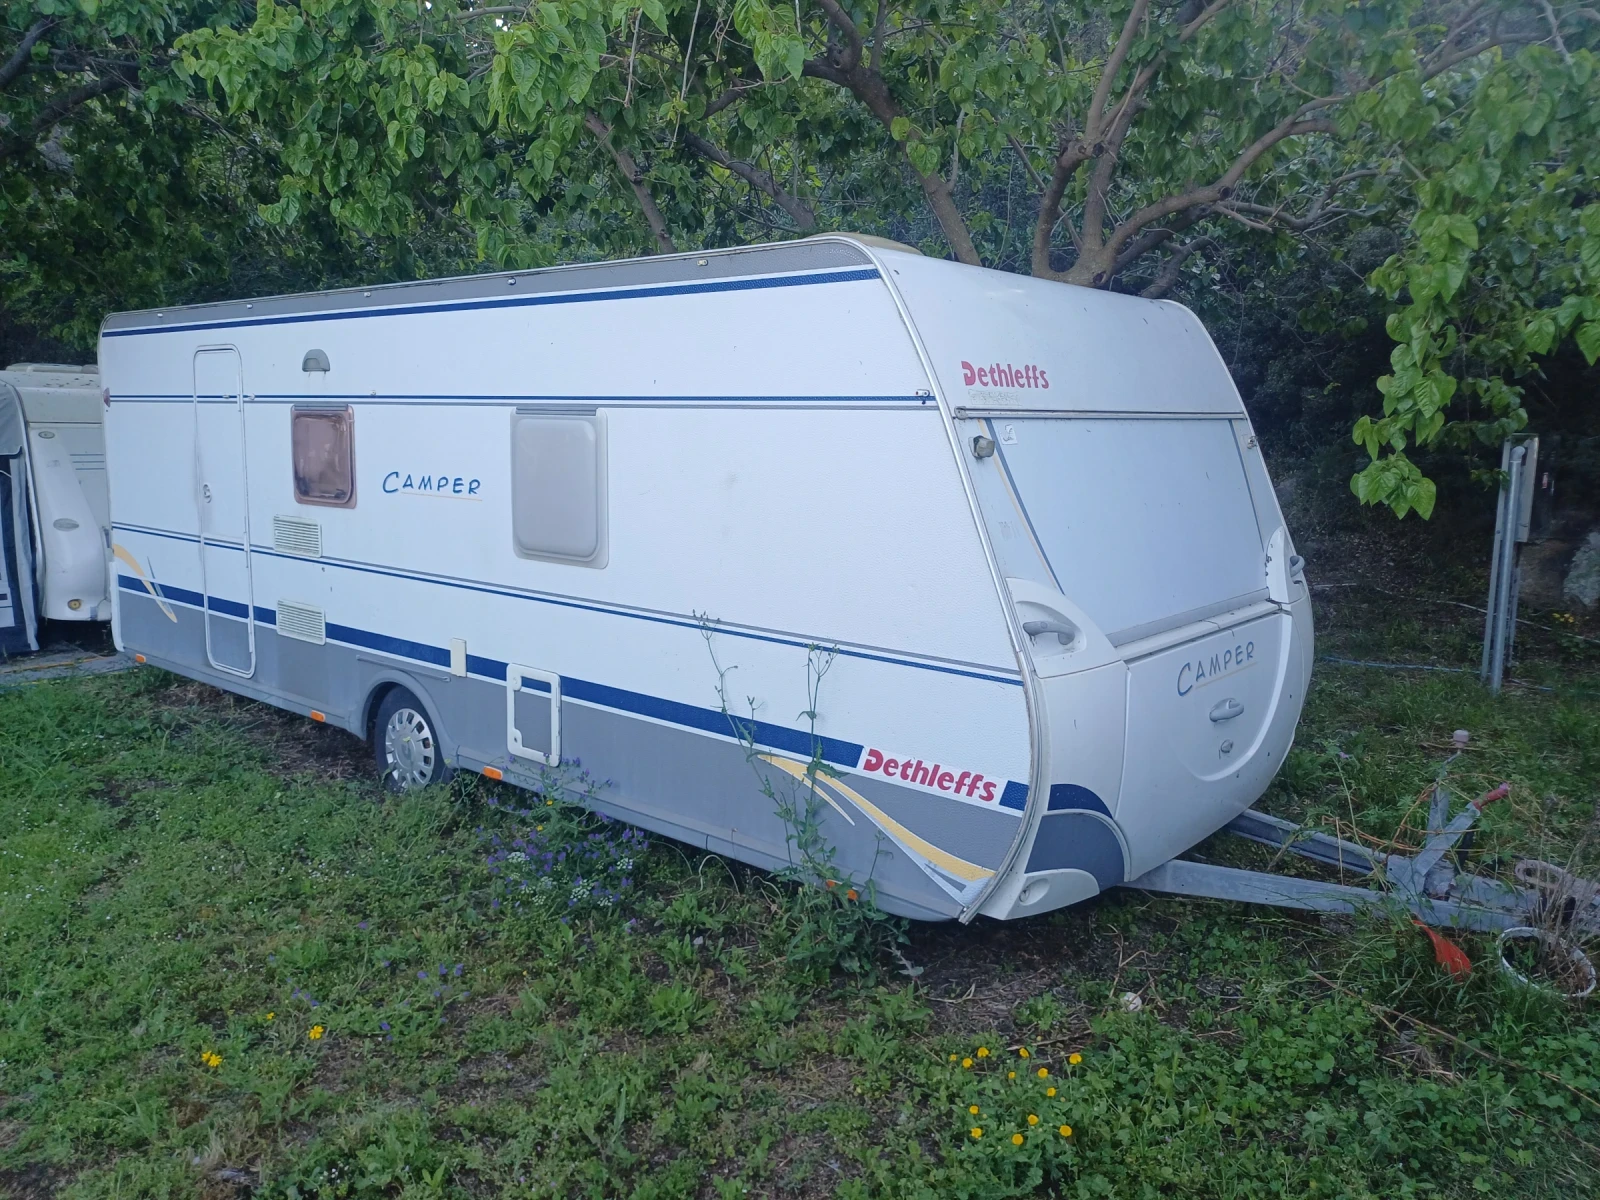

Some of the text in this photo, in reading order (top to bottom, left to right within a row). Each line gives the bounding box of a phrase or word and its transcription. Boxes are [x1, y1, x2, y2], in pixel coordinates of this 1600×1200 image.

[961, 360, 1049, 389] Dethleffs
[382, 471, 481, 495] CAMPER
[1177, 641, 1254, 696] CAMPER
[863, 748, 997, 802] Dethleffs
